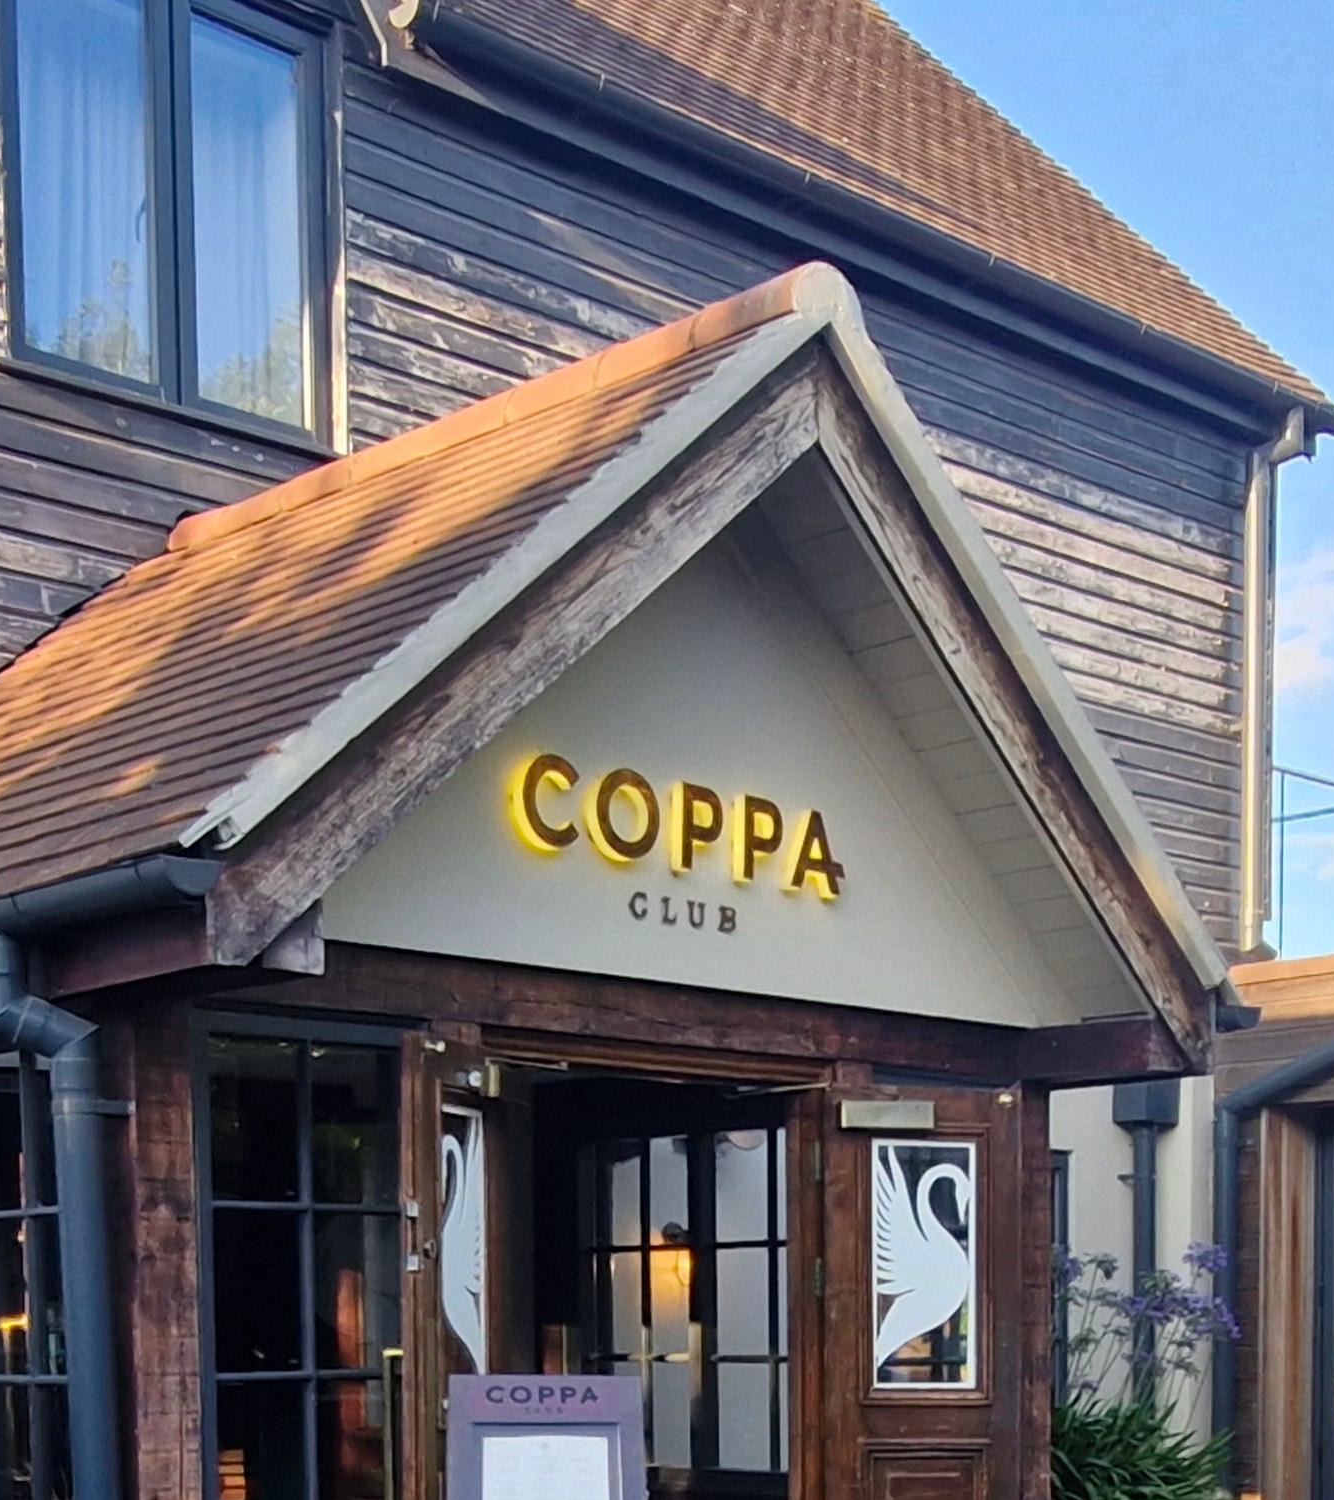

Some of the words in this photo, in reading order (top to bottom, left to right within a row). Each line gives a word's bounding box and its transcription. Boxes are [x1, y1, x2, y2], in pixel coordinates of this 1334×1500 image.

[513, 753, 846, 899] COPPA
[628, 892, 738, 933] CLUB
[485, 1385, 599, 1405] COPPA
